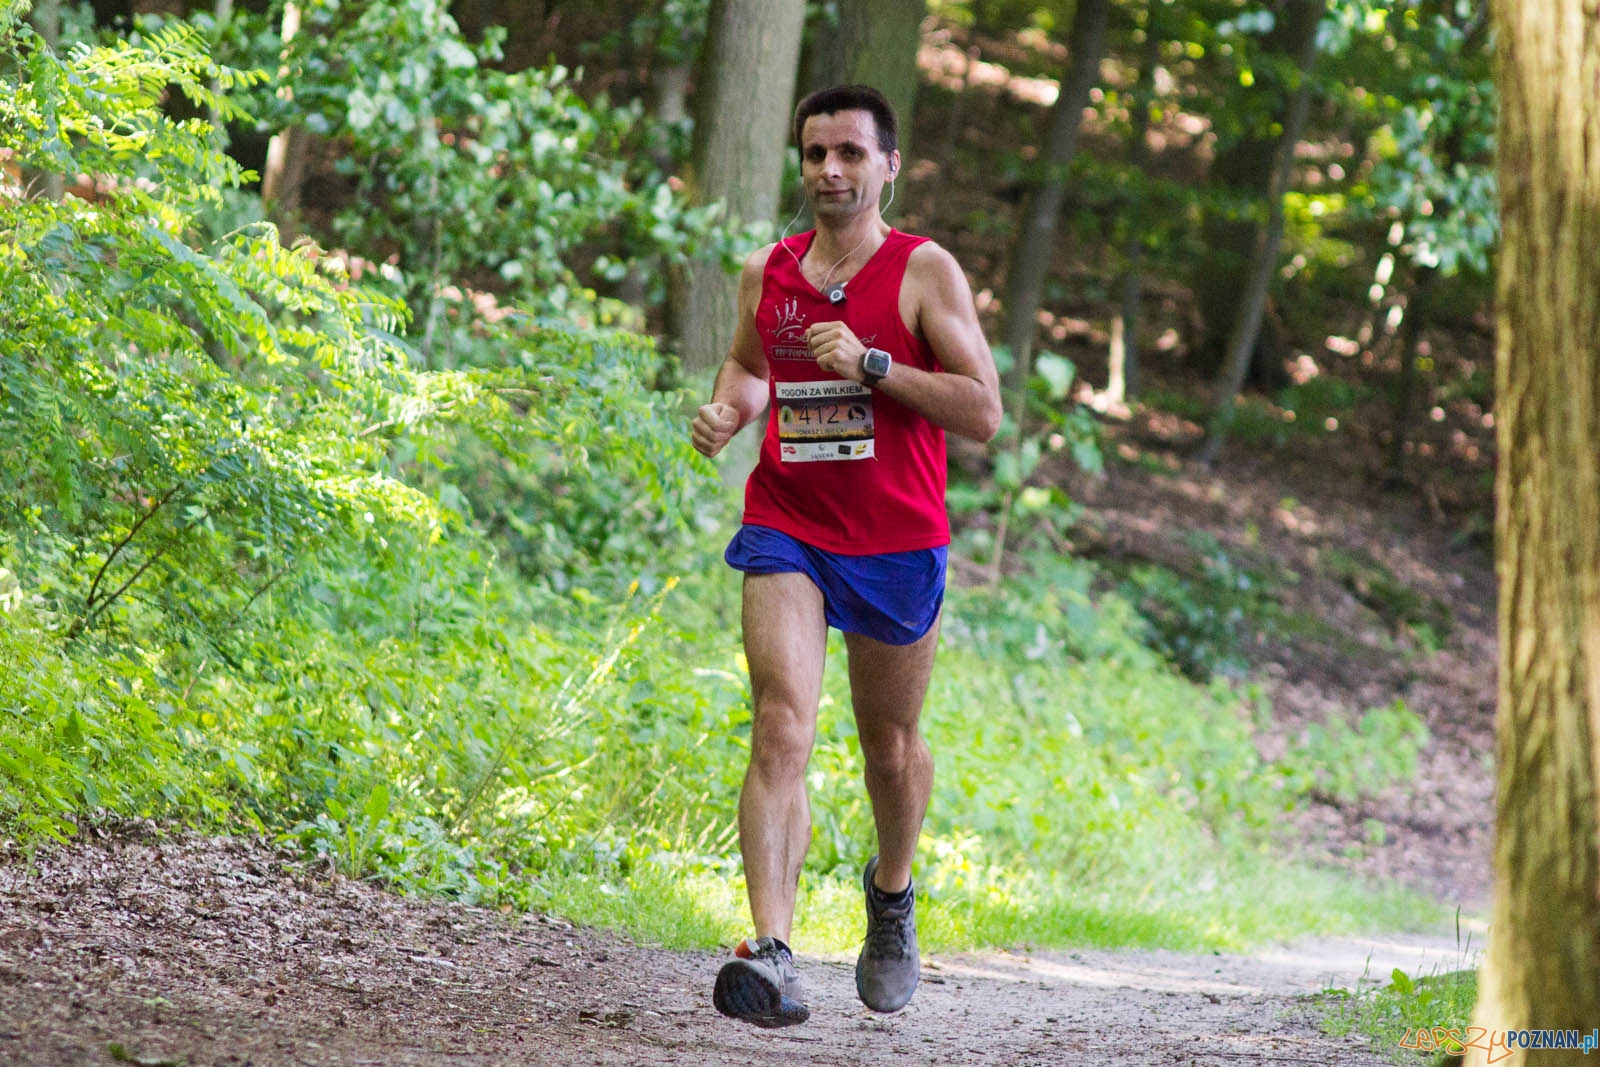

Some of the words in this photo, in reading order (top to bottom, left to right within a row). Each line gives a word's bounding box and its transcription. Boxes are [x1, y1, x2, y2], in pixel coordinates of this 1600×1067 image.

[809, 388, 822, 396] ZA
[823, 385, 863, 395] WILKIEM
[799, 404, 840, 425] 412
